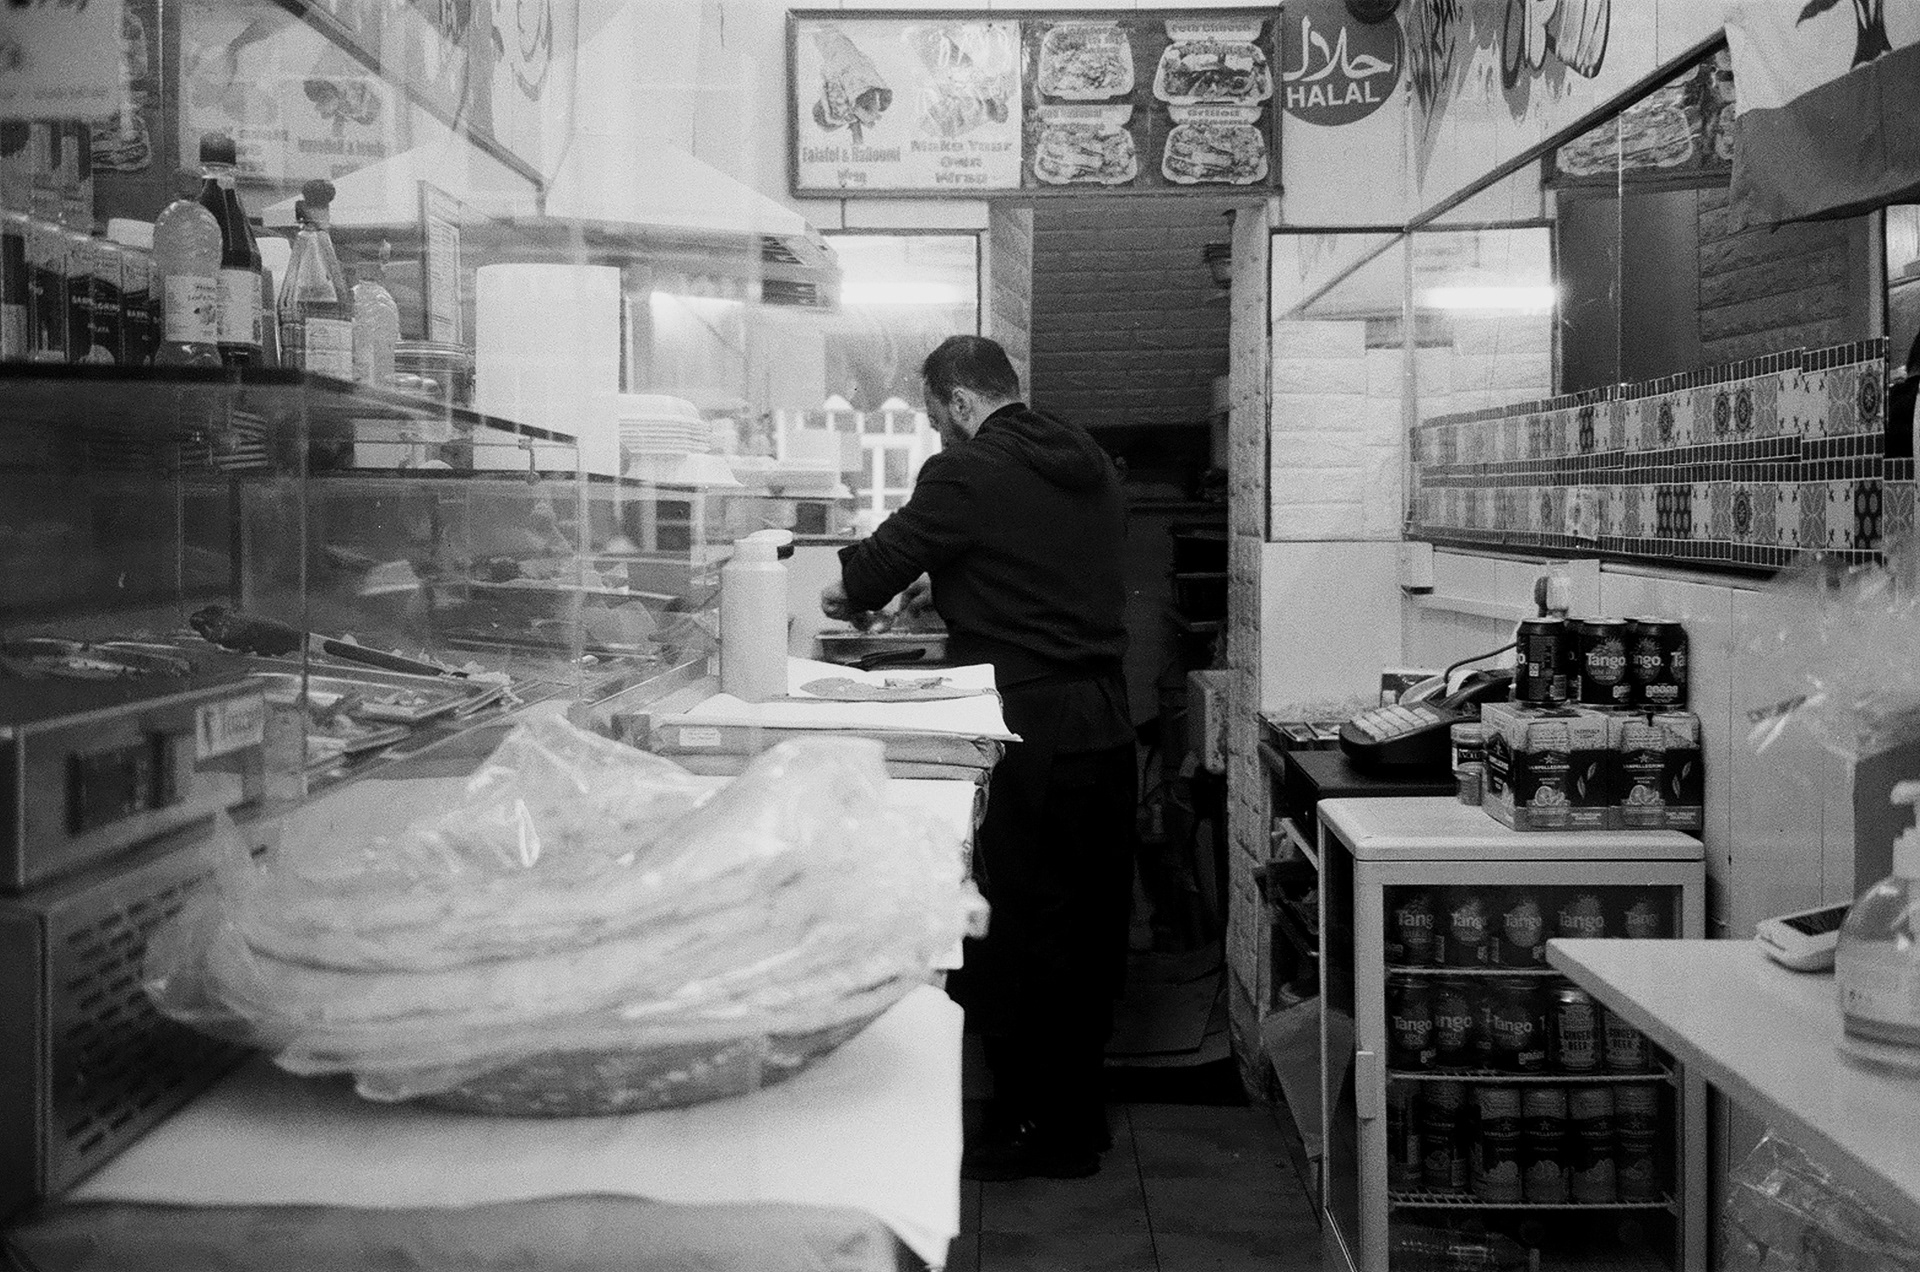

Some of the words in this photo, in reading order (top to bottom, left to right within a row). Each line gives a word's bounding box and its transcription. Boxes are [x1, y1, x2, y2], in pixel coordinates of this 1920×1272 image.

[1283, 15, 1393, 82] حلال
[1286, 81, 1381, 108] HALAL
[1557, 909, 1605, 932] Tango
[1392, 1015, 1432, 1034] Tango
[1493, 1014, 1533, 1034] Tango
